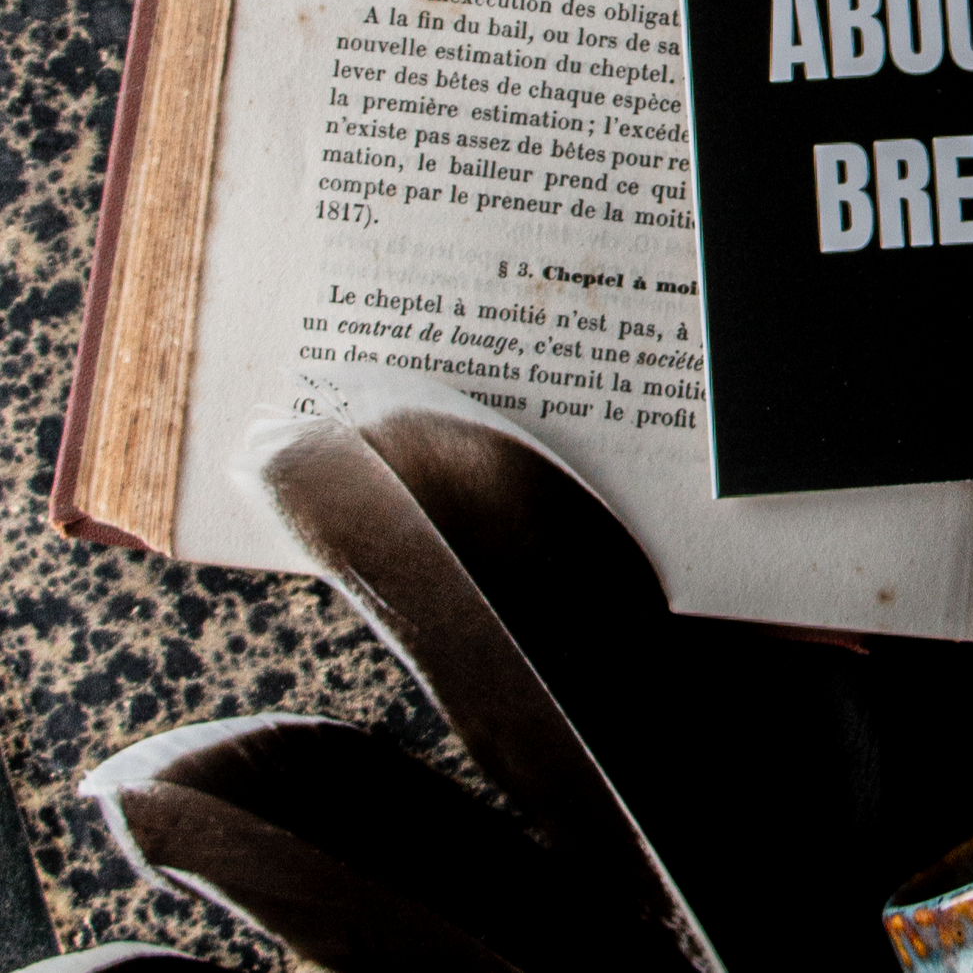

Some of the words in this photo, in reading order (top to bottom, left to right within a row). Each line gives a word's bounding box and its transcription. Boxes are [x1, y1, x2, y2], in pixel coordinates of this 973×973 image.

[336, 36, 428, 58] nouvelle
[434, 43, 548, 71] estimation
[554, 53, 583, 75] du
[588, 57, 676, 87] cheptel.
[332, 58, 387, 82] lever
[393, 65, 429, 87] des
[434, 68, 490, 93] bêtes
[496, 75, 522, 97] de
[527, 79, 606, 109] chaque
[611, 92, 682, 116] espèce
[317, 199, 379, 229] 1817).
[516, 261, 534, 279] 3.
[541, 264, 625, 290] Cheptel
[631, 275, 648, 292] à
[303, 316, 328, 332] un
[337, 319, 413, 340] contrat
[418, 322, 444, 343] de
[449, 324, 525, 357] louage,
[533, 335, 583, 359] c'est
[590, 346, 631, 364] une
